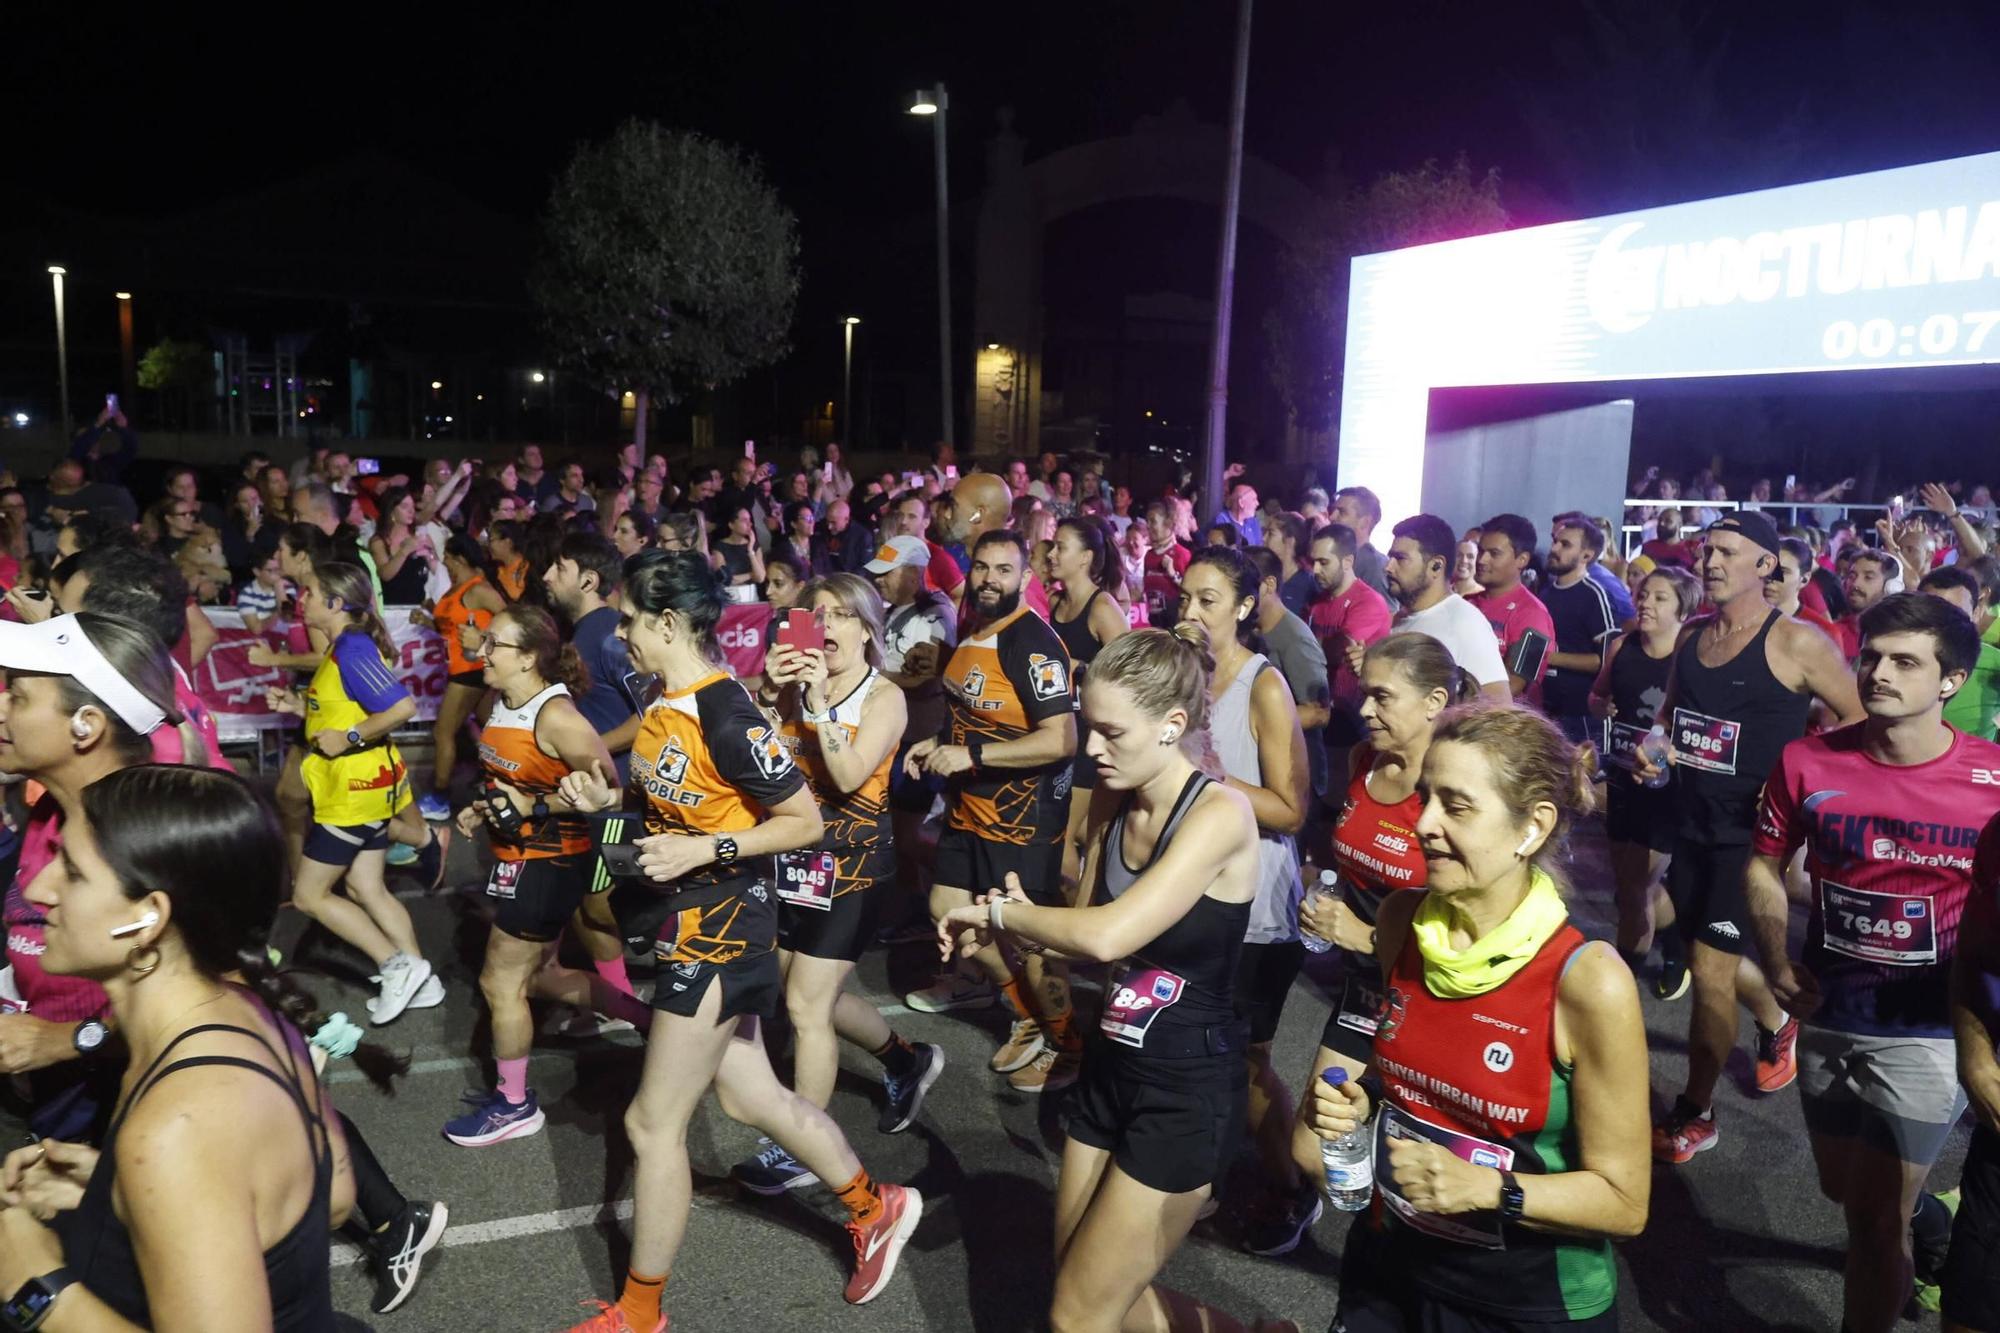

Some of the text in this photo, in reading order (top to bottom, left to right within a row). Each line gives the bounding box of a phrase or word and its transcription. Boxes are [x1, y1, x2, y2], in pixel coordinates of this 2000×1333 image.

[1681, 729, 1723, 754] 9986
[786, 866, 827, 887] 8045
[1353, 849, 1383, 873] URBAN
[1385, 863, 1413, 881] WAY
[1838, 909, 1913, 940] 7649
[1430, 1077, 1484, 1116] URBAN
[1486, 1101, 1530, 1124] WAY
